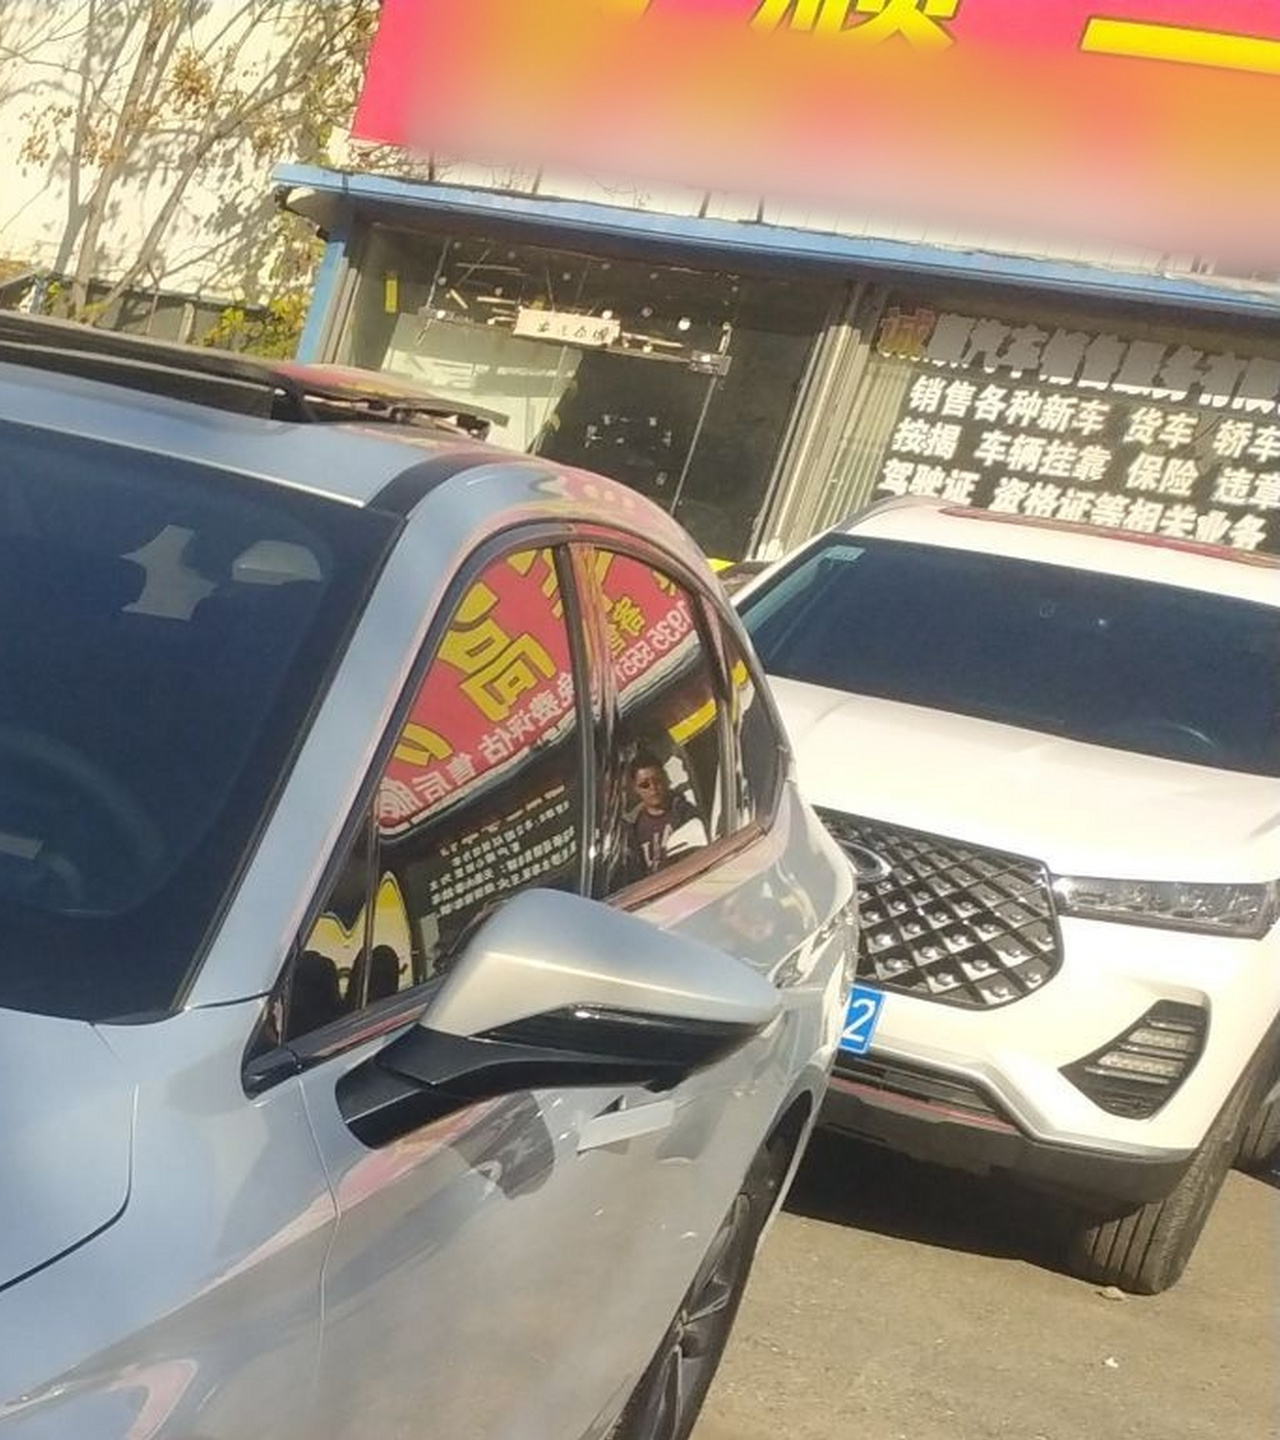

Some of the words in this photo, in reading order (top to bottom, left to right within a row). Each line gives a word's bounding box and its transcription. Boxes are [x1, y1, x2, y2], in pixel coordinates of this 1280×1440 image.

[910, 375, 1110, 436] 销售各种新车
[1123, 408, 1199, 448] 货车
[878, 458, 981, 505] 驾驶证
[891, 417, 962, 460] 按揭
[974, 430, 1112, 481] 车辆挂靠
[1126, 452, 1199, 497] 保险
